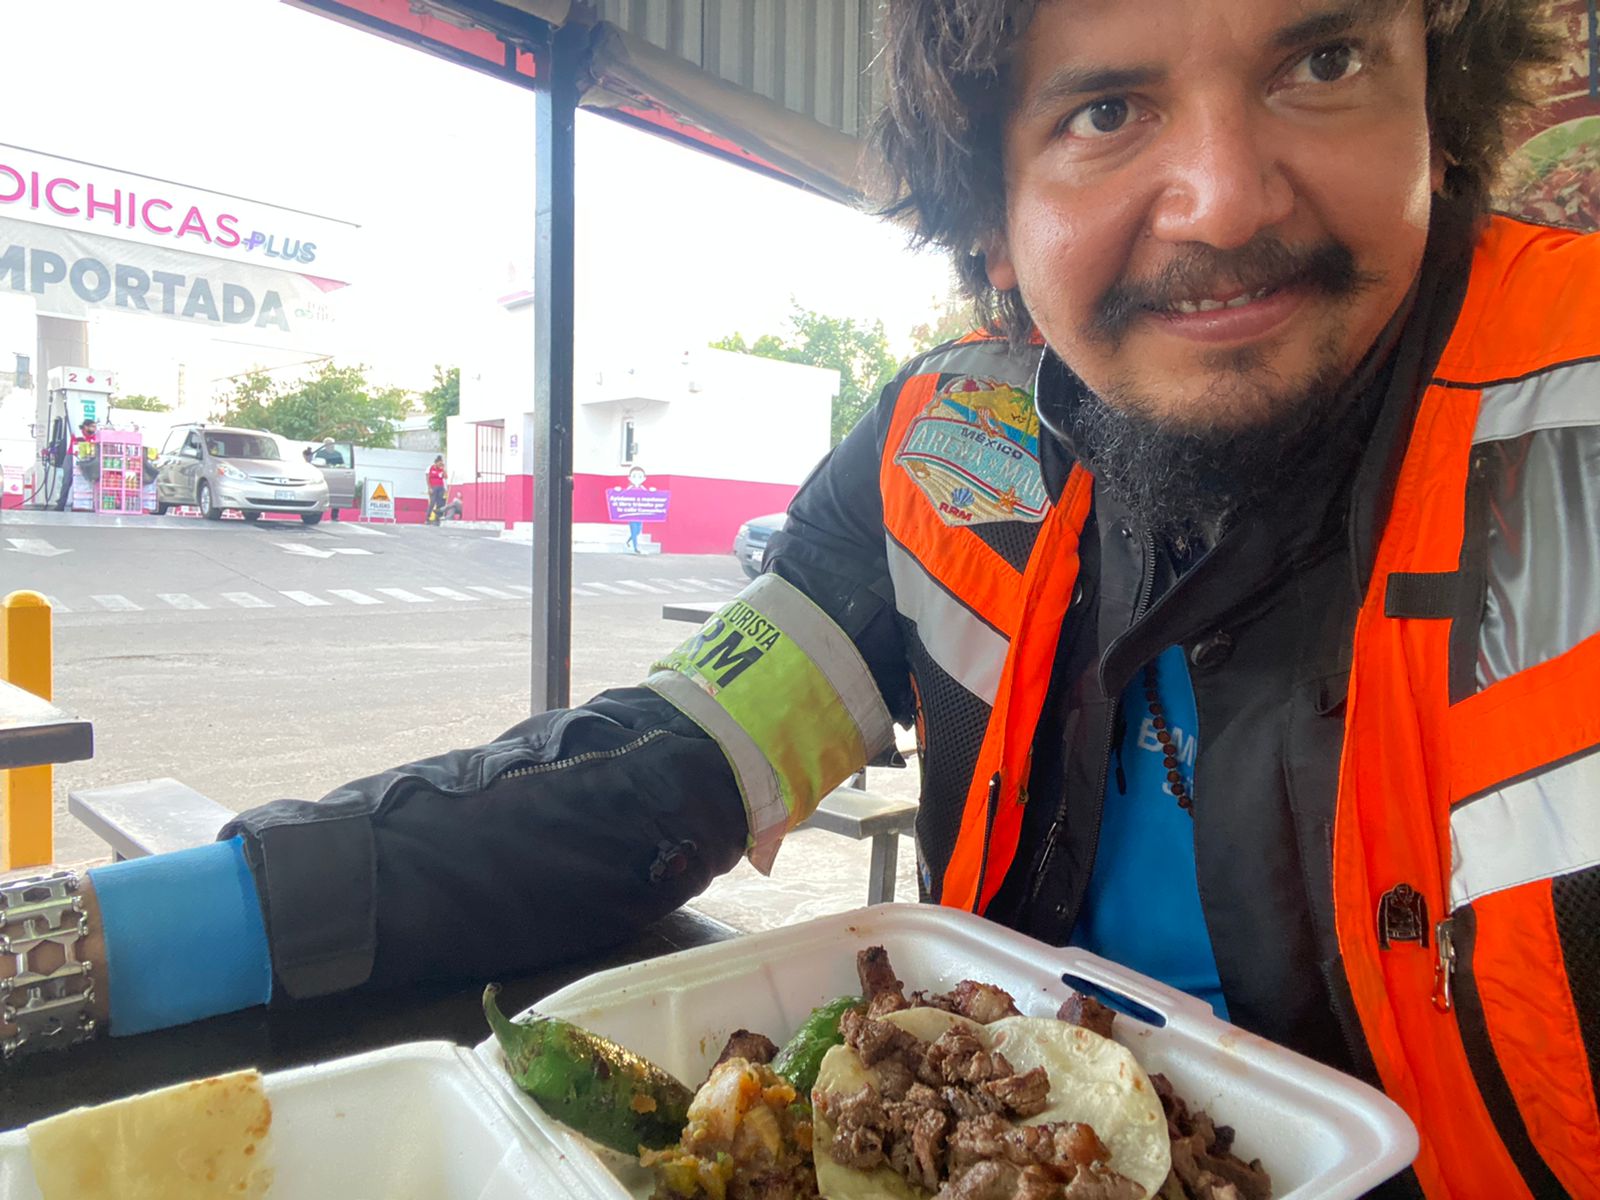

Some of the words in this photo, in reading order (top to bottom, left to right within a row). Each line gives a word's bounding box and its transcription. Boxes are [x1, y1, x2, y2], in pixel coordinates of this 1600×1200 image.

[69, 373, 78, 383] 2
[910, 427, 982, 467] ARENA
[960, 426, 1024, 460] MÉXICO
[724, 602, 781, 651] TURISTA
